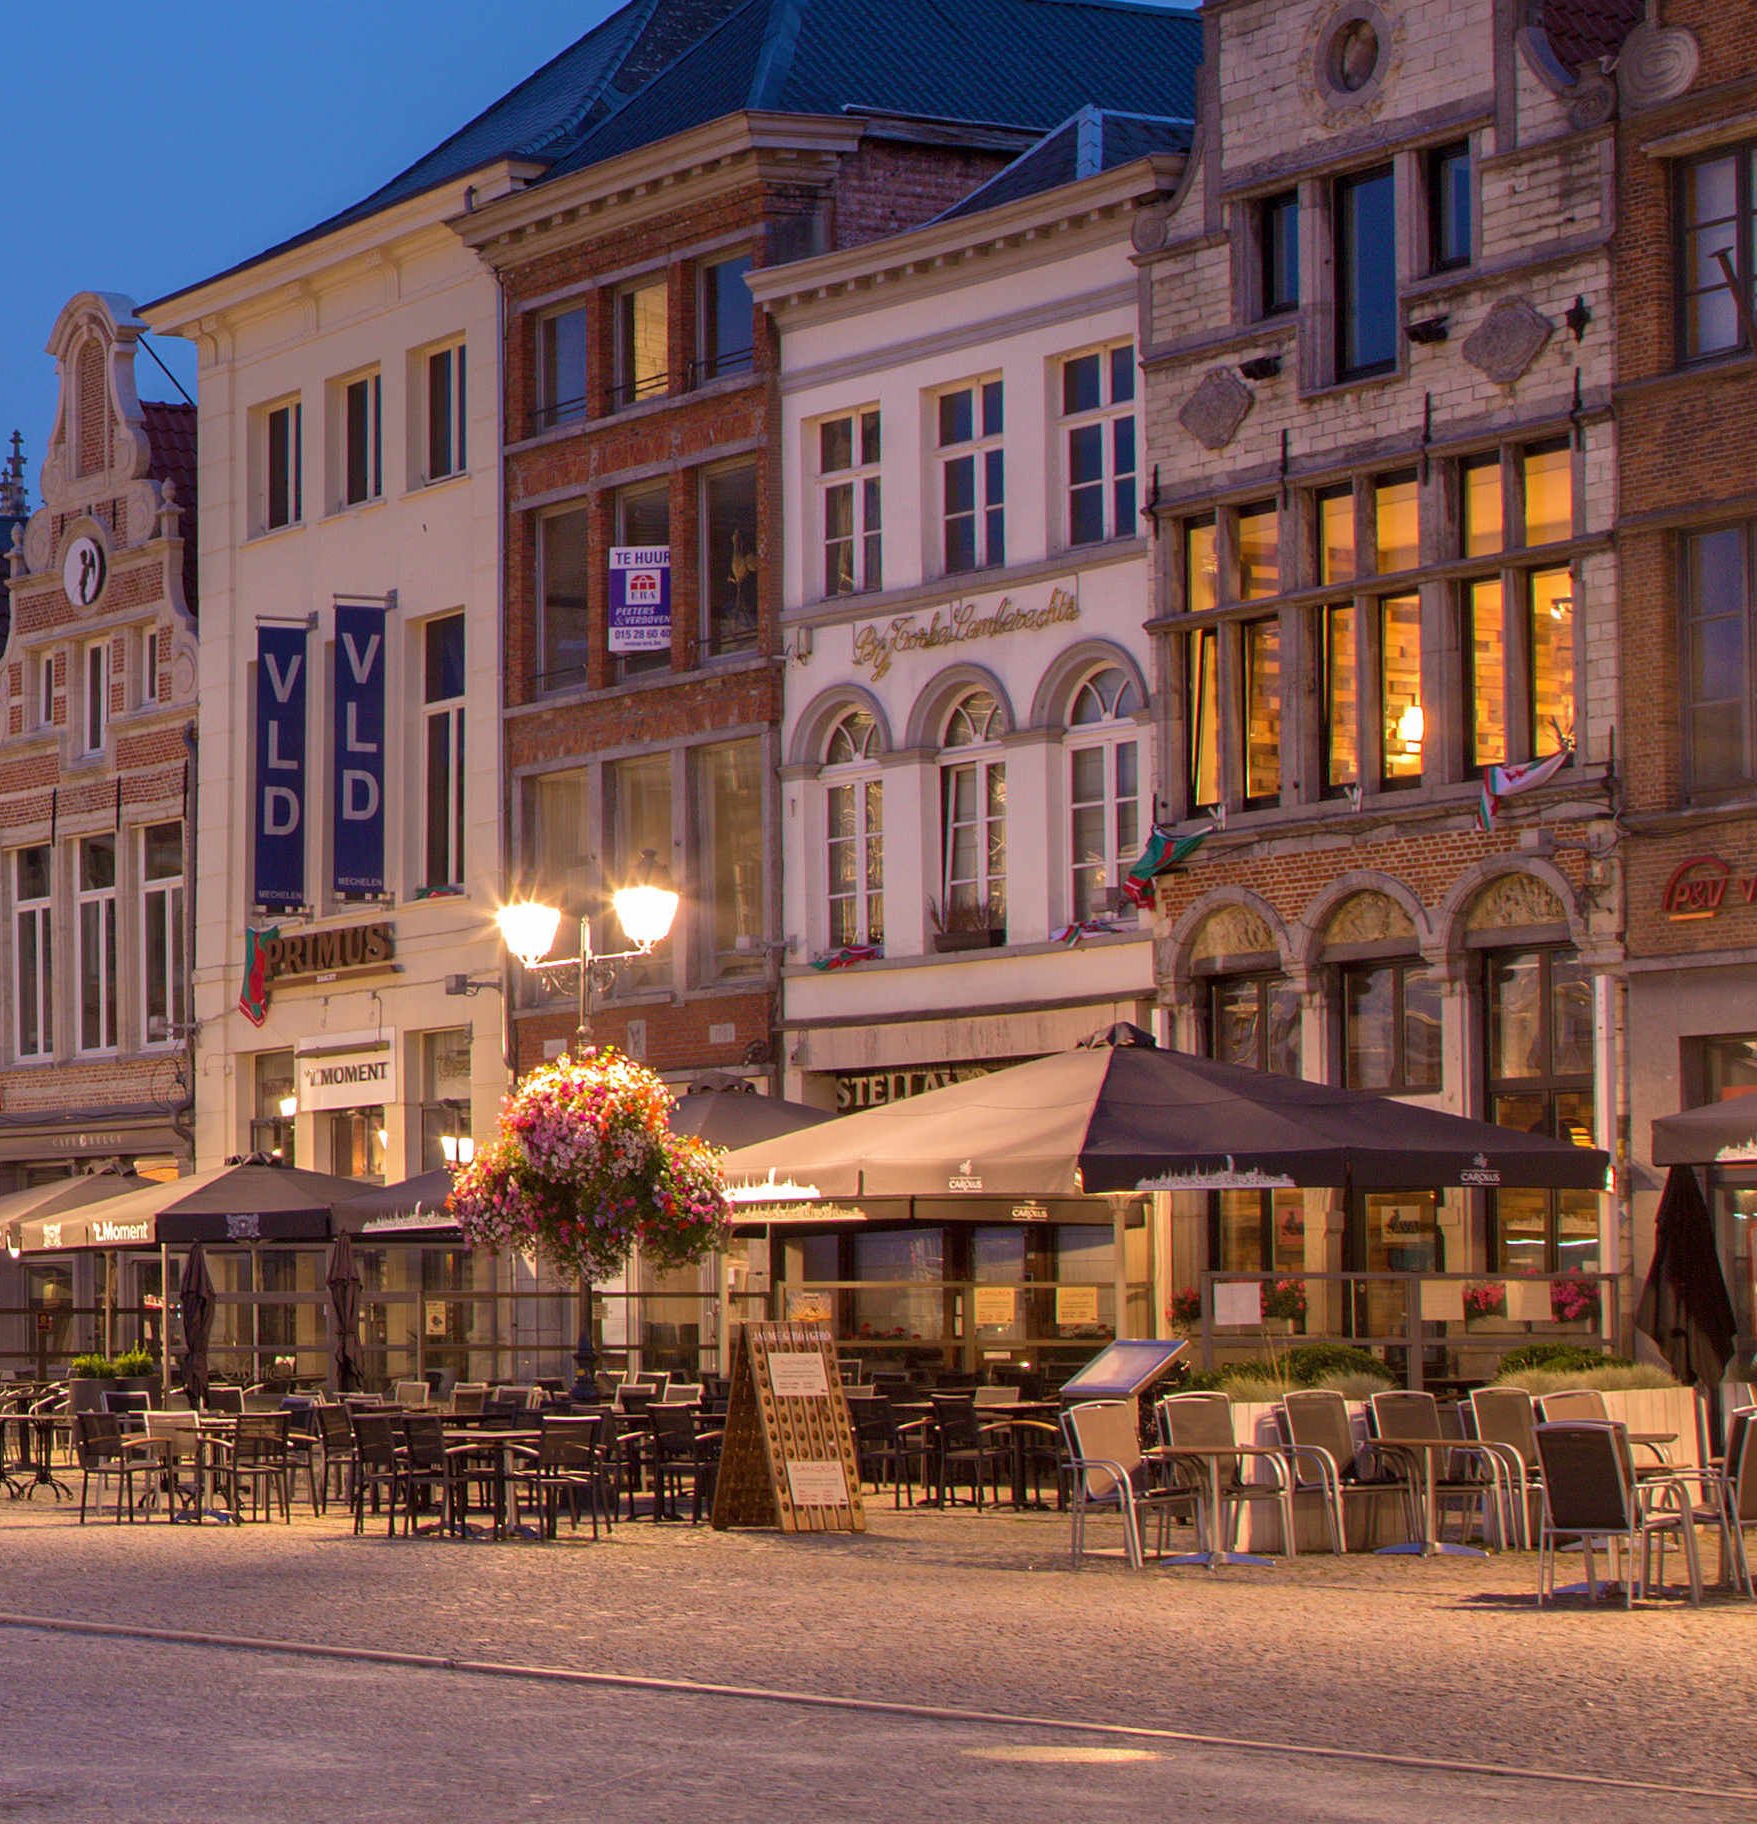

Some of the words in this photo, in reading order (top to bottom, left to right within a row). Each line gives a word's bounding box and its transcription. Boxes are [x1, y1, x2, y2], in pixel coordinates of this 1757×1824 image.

[615, 552, 631, 565] TE
[635, 551, 671, 565] HUUR
[630, 590, 657, 600] ERA
[615, 606, 656, 616] PEETERS
[614, 629, 632, 640] 015
[646, 628, 658, 639] 60
[338, 877, 383, 887] MECHELEN
[258, 889, 303, 900] MECHELEN
[263, 922, 389, 979] PRIMUS
[320, 1061, 390, 1086] MOMENT
[836, 1072, 946, 1109] STELLA
[1460, 1172, 1501, 1184] CAROLUS
[949, 1179, 983, 1191] CAROLUS
[1011, 1208, 1048, 1220] CAROLUS
